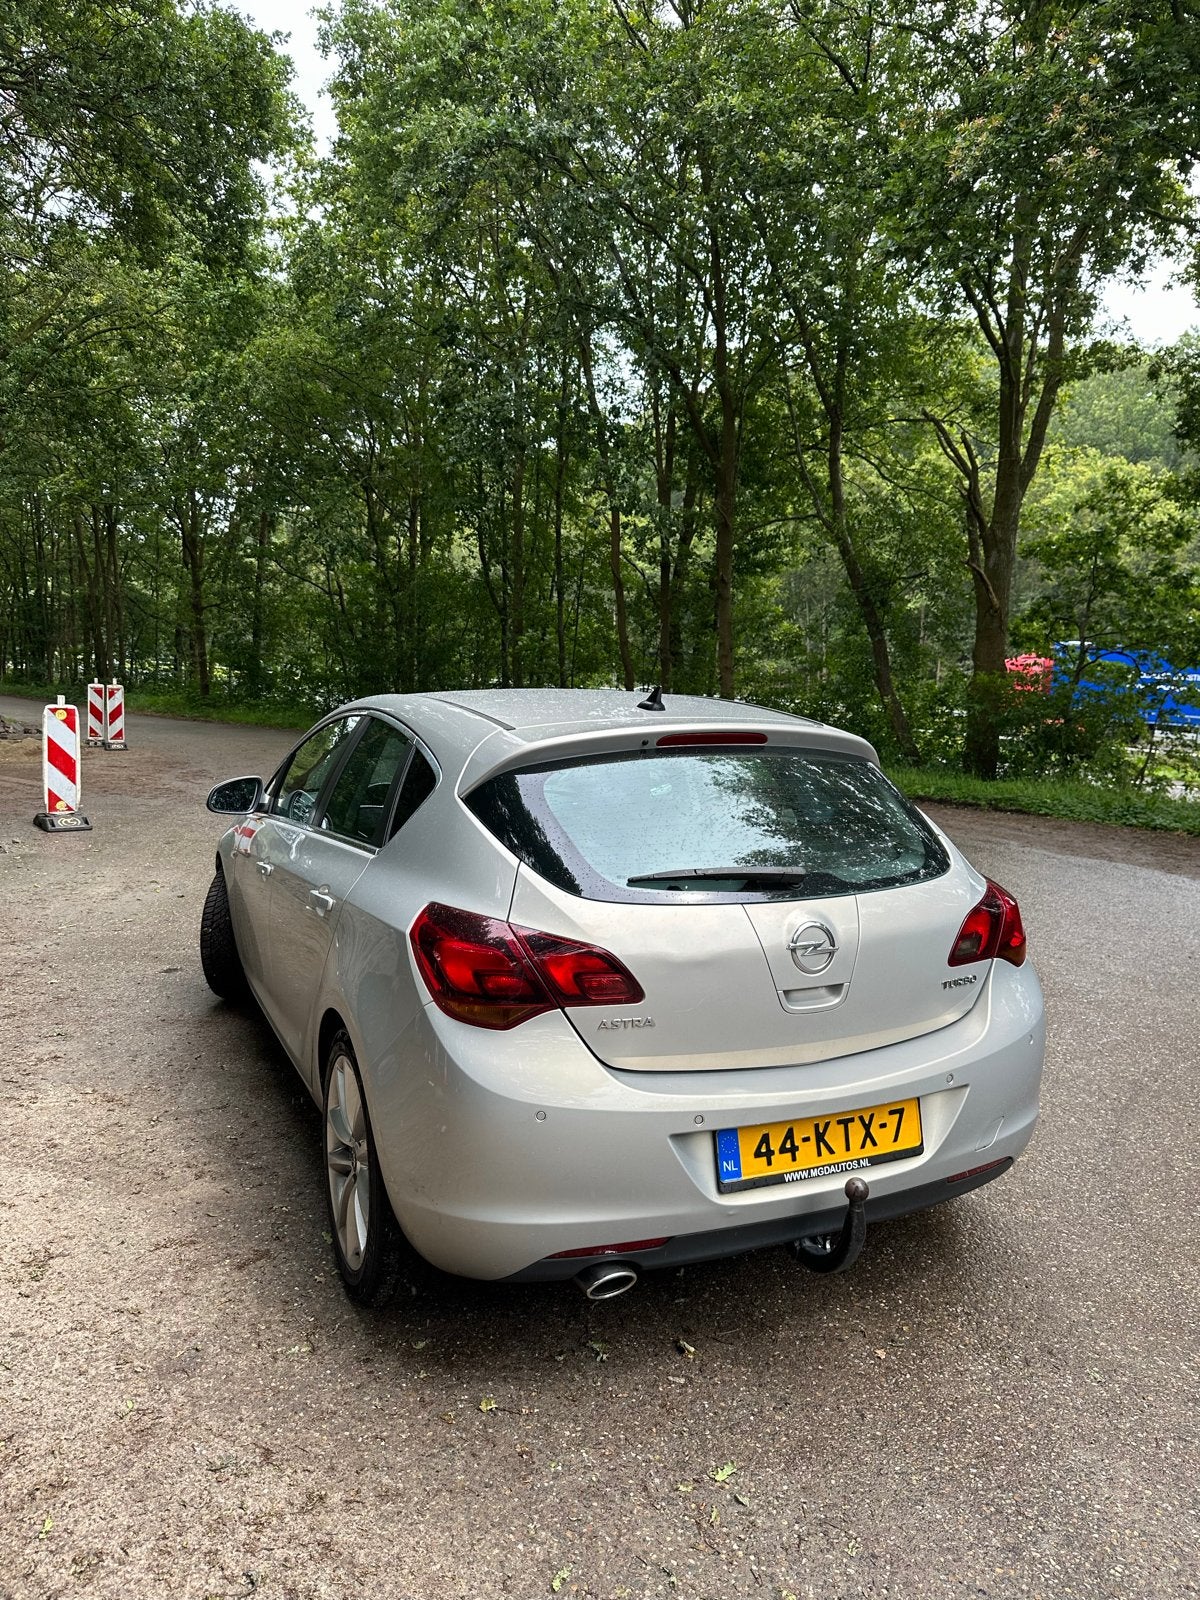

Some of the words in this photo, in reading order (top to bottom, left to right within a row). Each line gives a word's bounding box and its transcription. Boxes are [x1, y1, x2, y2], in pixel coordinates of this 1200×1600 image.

[941, 974, 977, 990] TURBO
[596, 1016, 656, 1031] ASTRA
[753, 1107, 905, 1166] 44-KTX-7
[723, 1160, 738, 1172] NL
[783, 1157, 872, 1183] WWW.MGDAUTOS.NL
